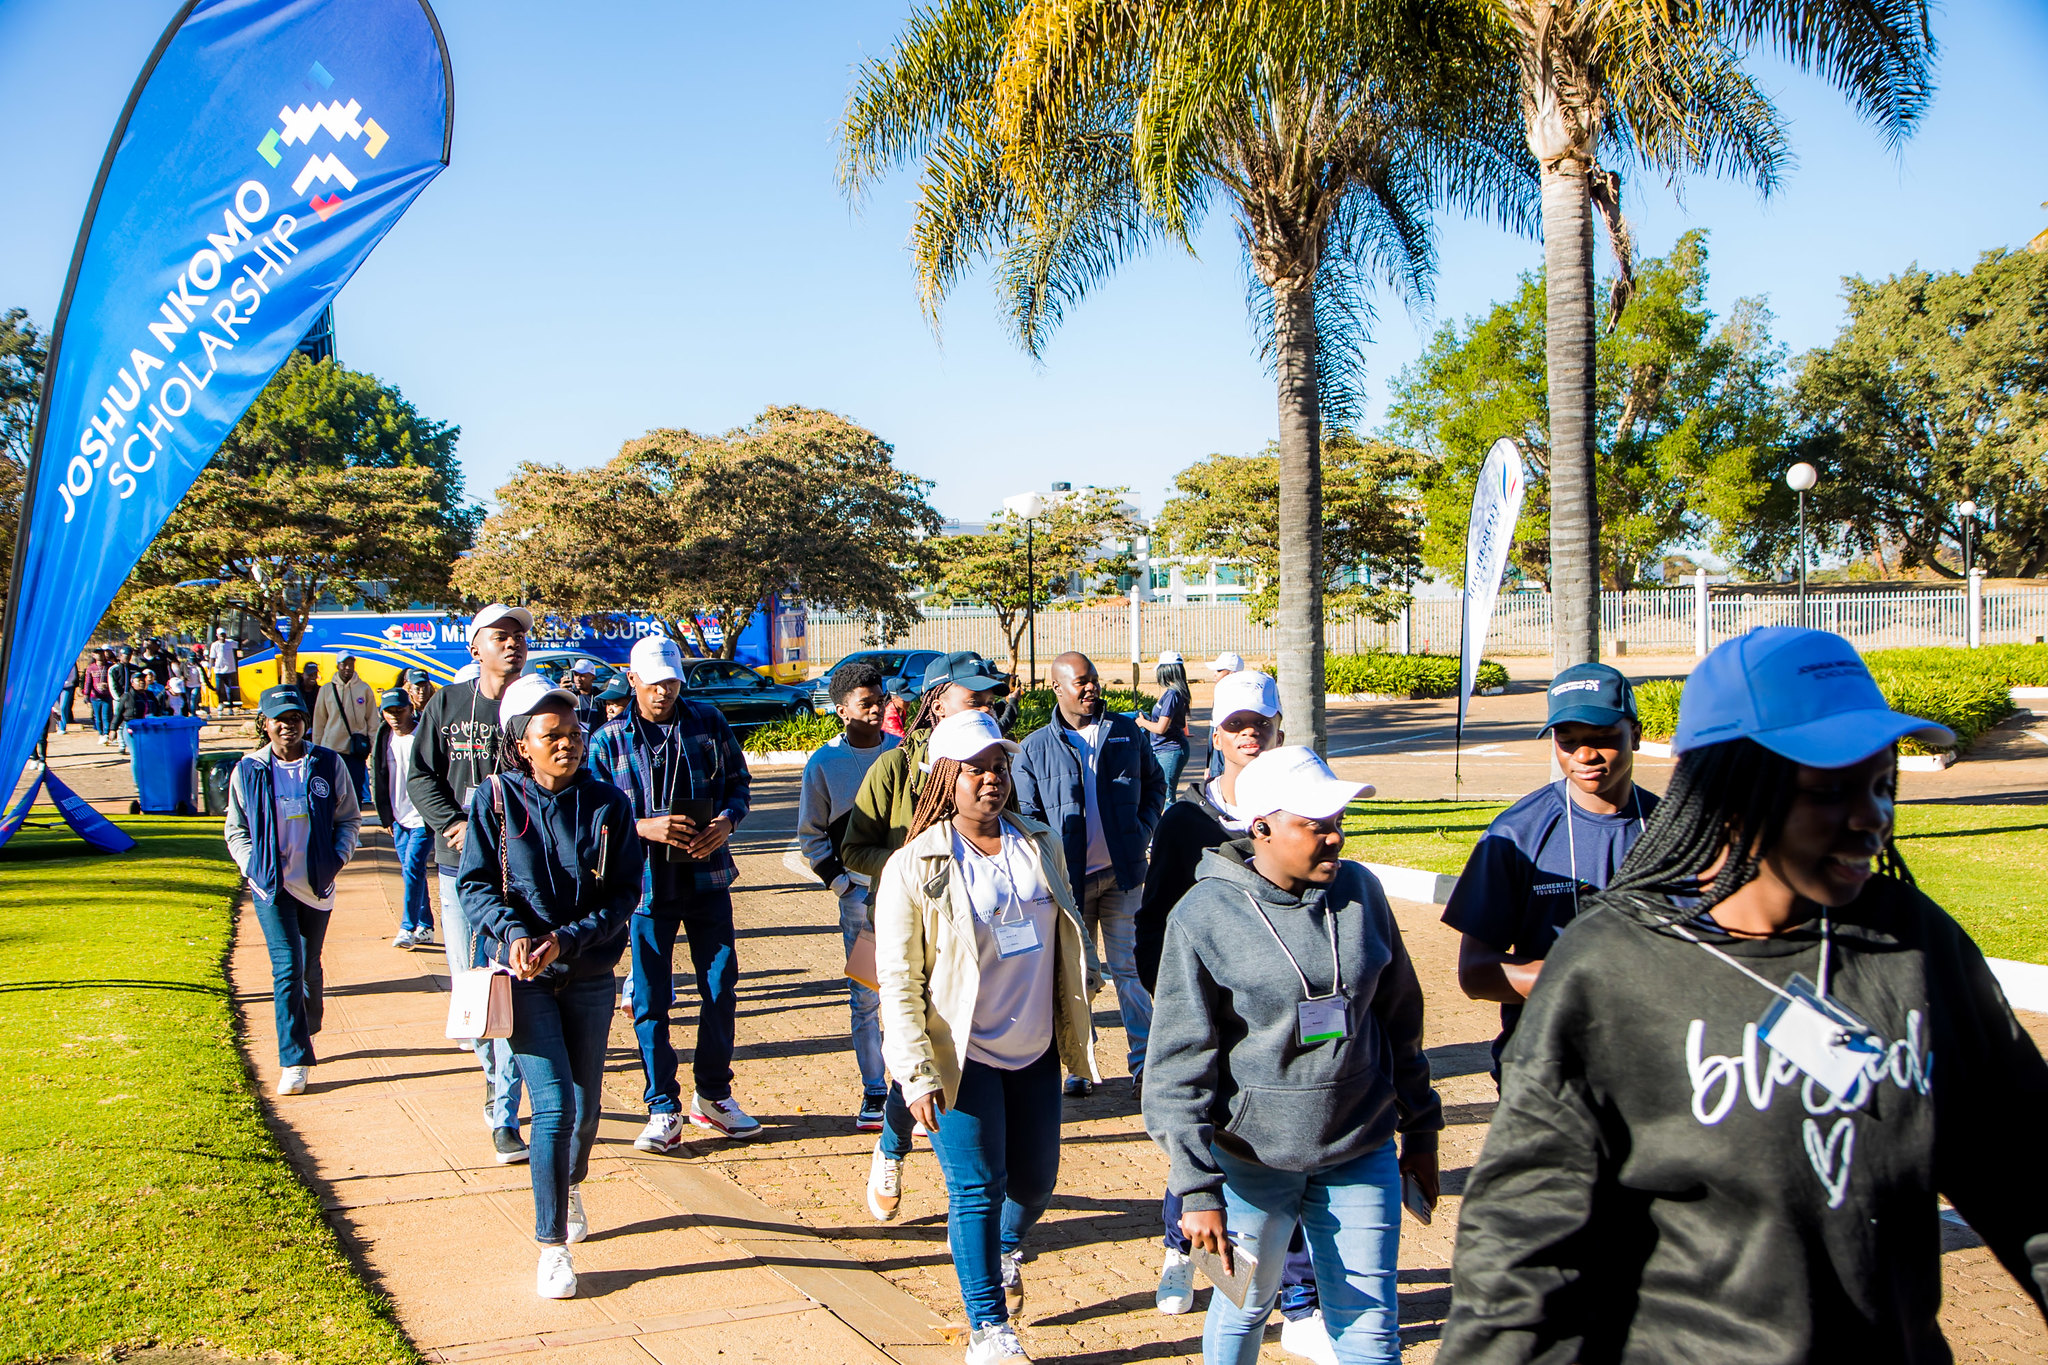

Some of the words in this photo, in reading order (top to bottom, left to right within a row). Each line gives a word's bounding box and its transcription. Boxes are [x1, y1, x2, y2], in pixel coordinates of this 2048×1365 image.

[58, 348, 165, 524] JOSHUA
[148, 180, 271, 354] NKOMO
[108, 213, 299, 500] SCHOLARSHIP
[403, 622, 431, 632] MIN
[404, 631, 430, 639] TRAVEL
[592, 621, 665, 640] OURS
